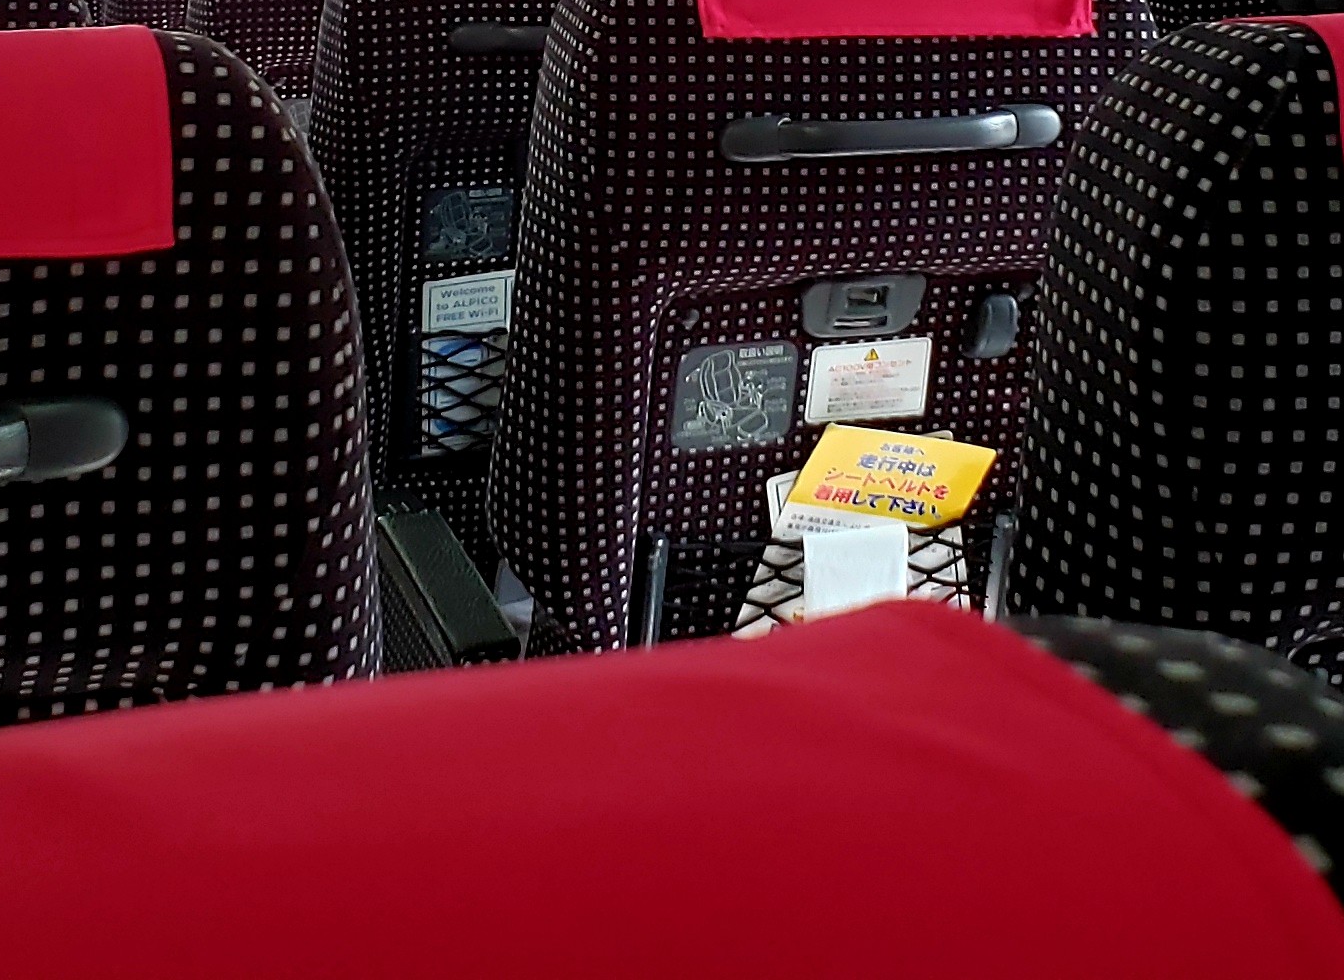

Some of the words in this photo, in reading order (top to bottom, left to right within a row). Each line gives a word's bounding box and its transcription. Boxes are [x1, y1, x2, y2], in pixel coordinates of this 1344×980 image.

[440, 284, 496, 299] Welcome
[452, 295, 499, 309] ALPICO
[857, 453, 937, 478] 走行中は
